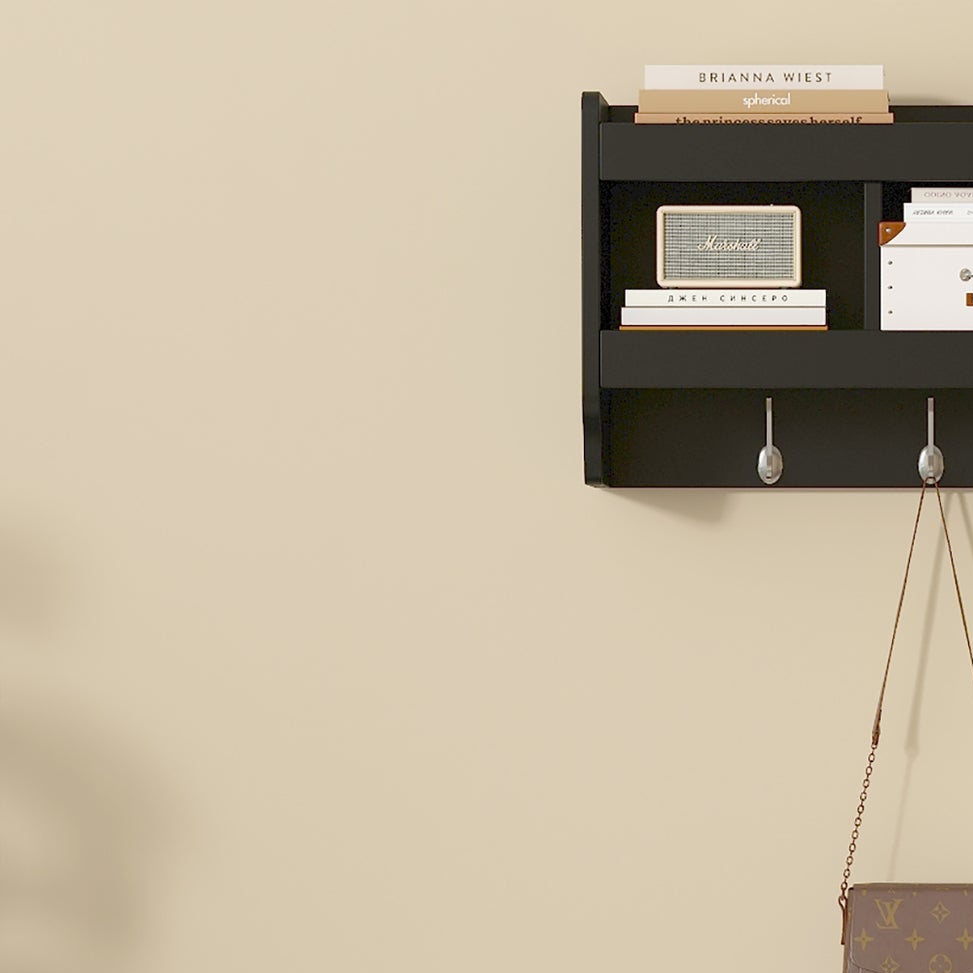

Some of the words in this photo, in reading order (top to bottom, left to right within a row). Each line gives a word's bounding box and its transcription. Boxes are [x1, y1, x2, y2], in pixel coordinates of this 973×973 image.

[698, 72, 776, 83] BRIANNA
[783, 72, 833, 83] WIEST
[742, 92, 791, 109] spherical
[697, 234, 762, 251] Marshall
[667, 295, 708, 303] ДЖЕН
[719, 295, 789, 303] СИНСЕРО
